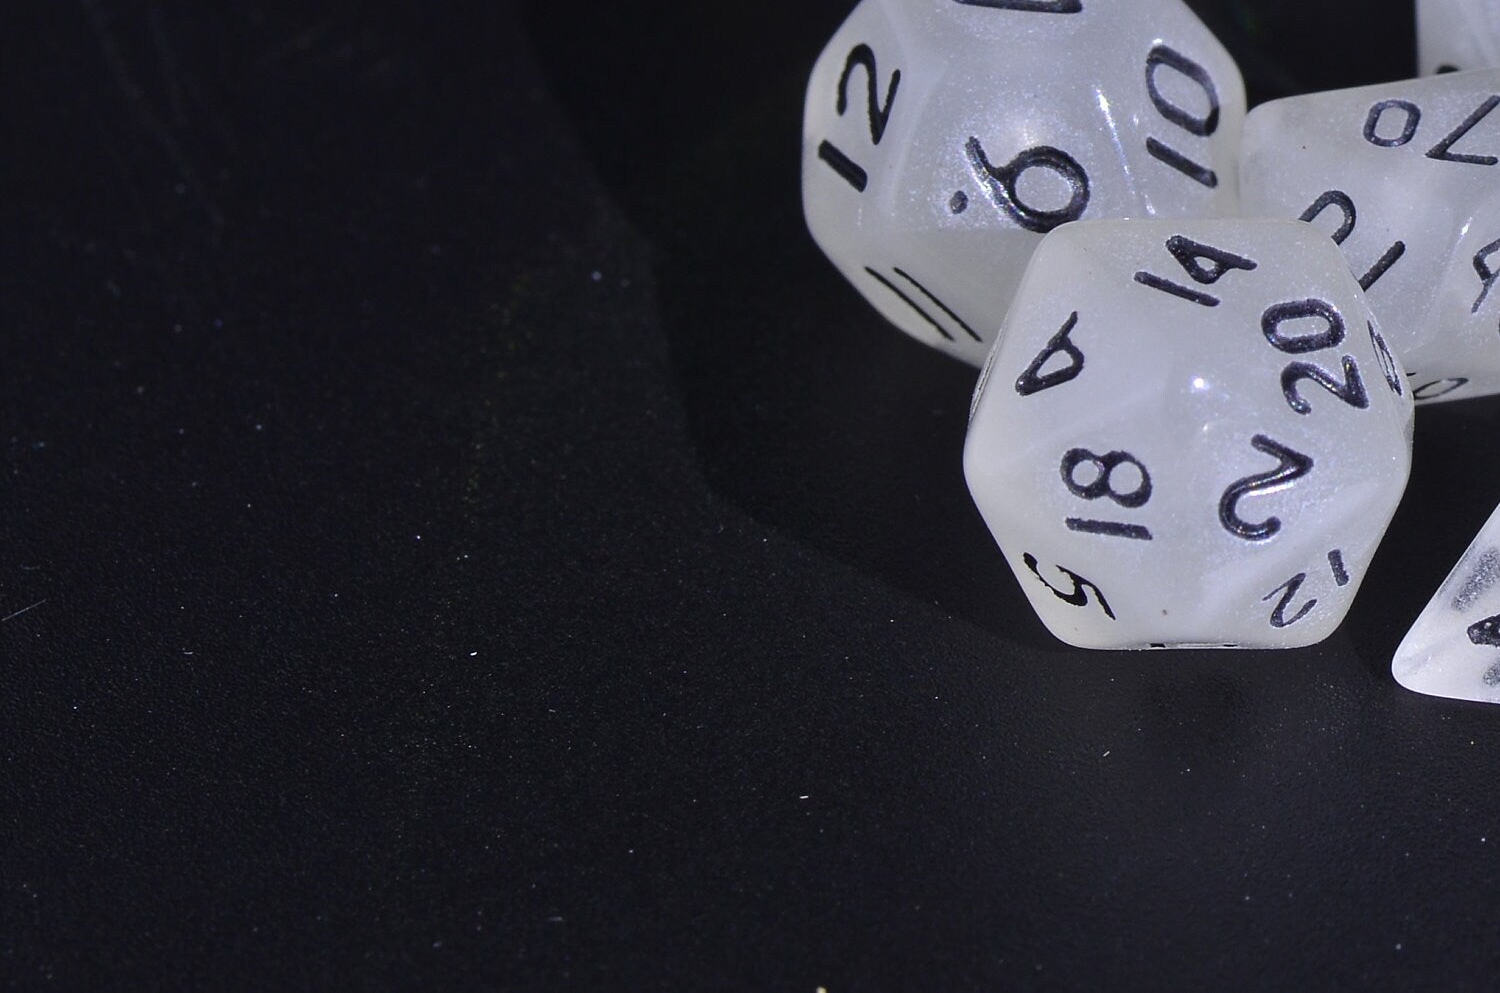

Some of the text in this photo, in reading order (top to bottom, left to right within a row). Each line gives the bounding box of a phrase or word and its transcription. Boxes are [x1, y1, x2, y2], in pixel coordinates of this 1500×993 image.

[818, 43, 900, 193] 12
[1144, 44, 1219, 189] 10
[1134, 234, 1257, 308] 14
[1015, 311, 1085, 396] 4
[1261, 297, 1369, 415] 20
[1060, 447, 1153, 541] 18
[1219, 433, 1314, 541] 2
